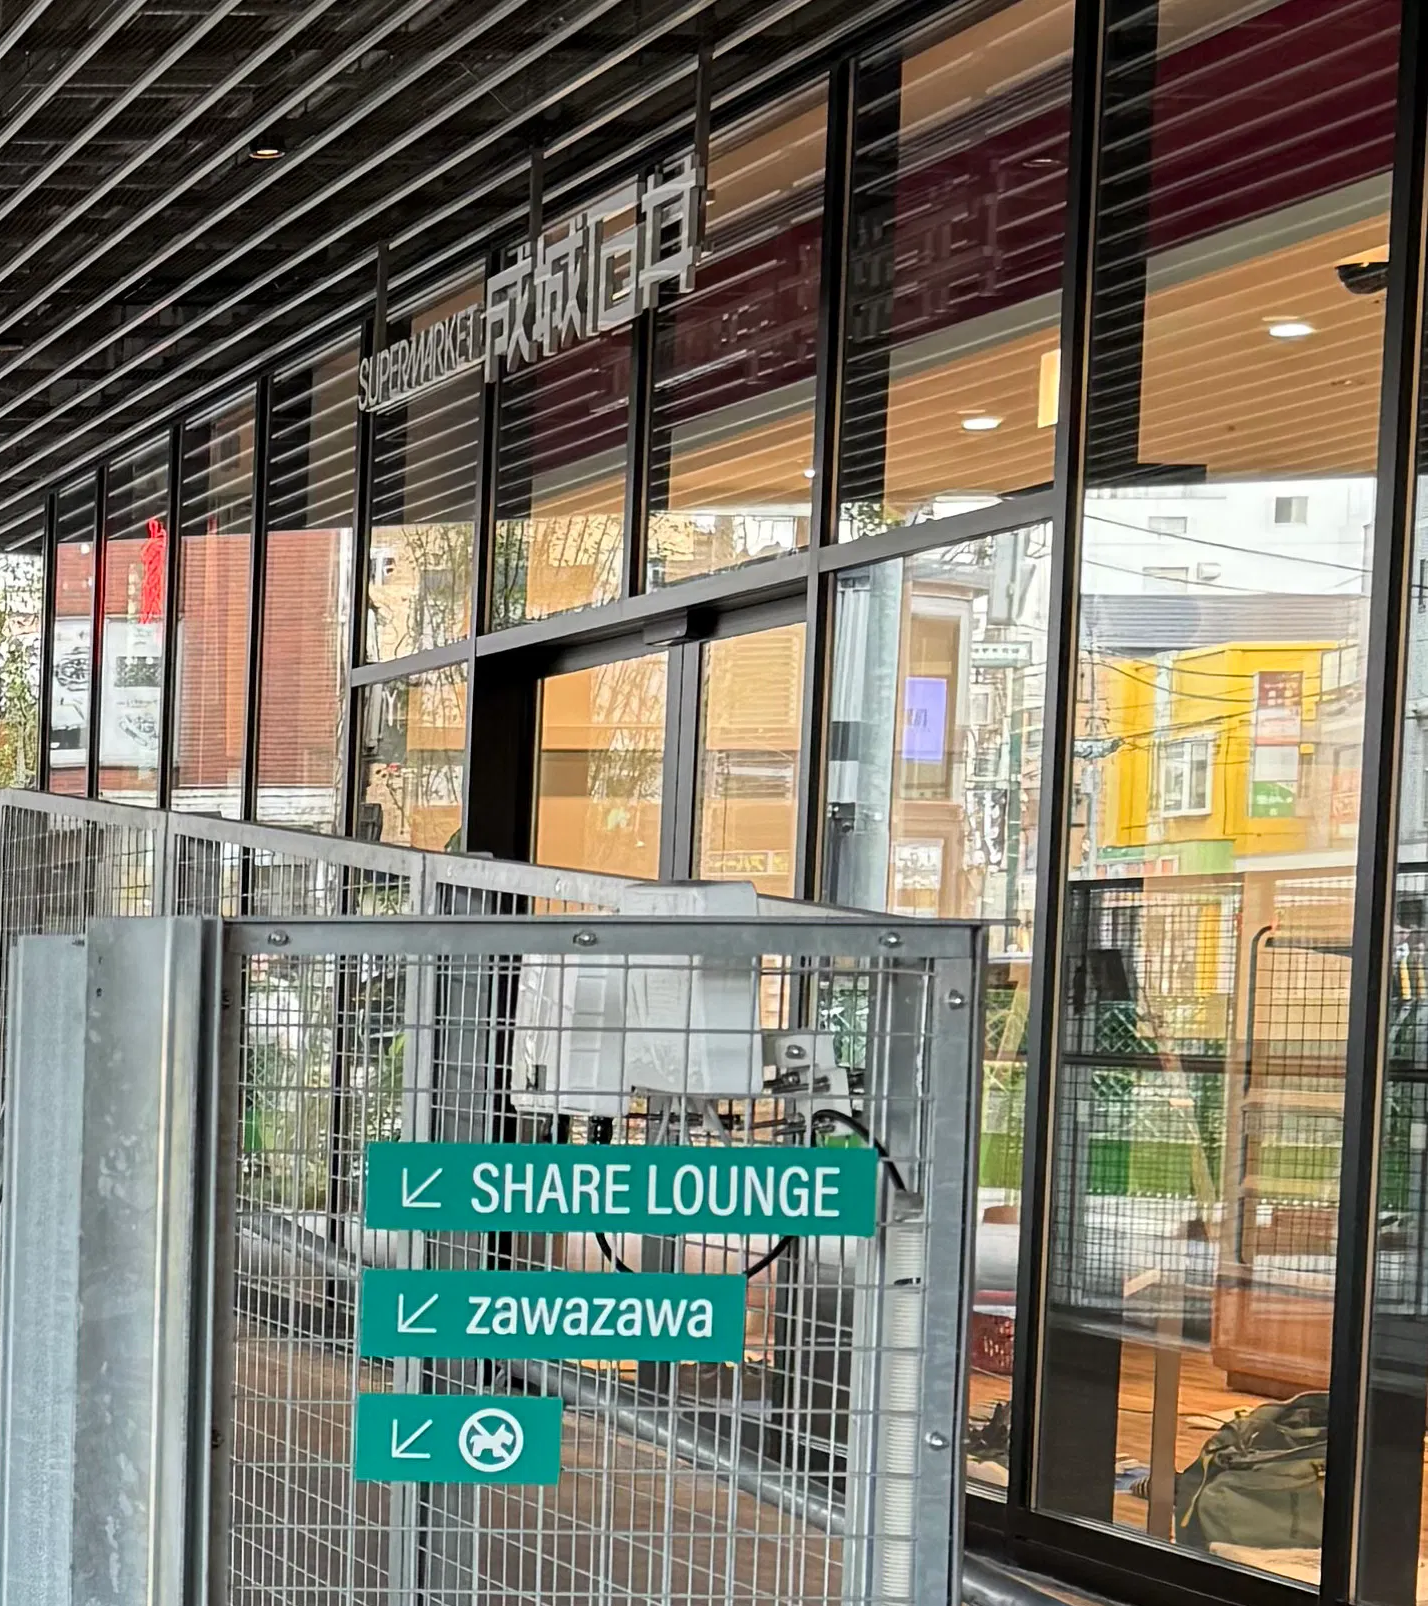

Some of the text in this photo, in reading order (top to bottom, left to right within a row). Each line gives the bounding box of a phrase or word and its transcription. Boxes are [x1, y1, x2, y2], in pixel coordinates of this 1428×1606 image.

[484, 152, 700, 384] 成城石井
[358, 304, 484, 411] SUPERMARKET
[471, 1162, 840, 1218] SHARE LOUNGE
[465, 1295, 713, 1339] zawazawa
